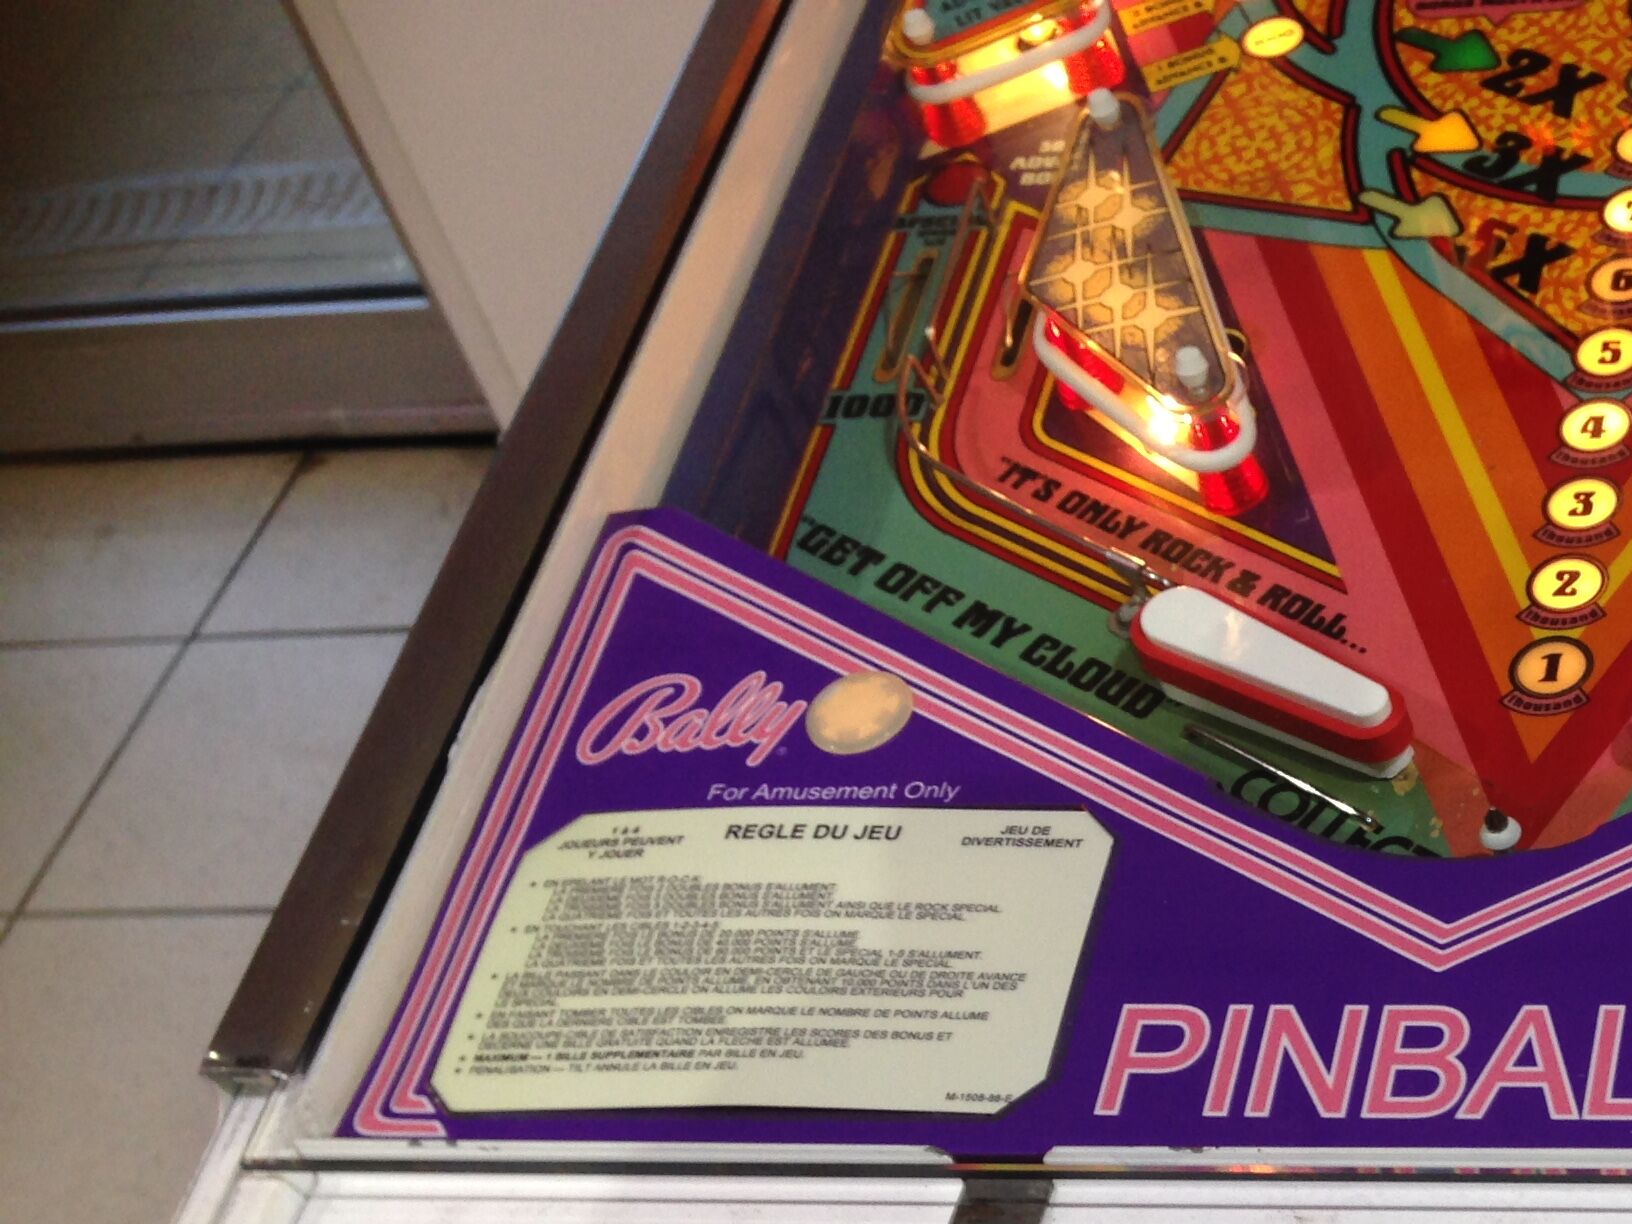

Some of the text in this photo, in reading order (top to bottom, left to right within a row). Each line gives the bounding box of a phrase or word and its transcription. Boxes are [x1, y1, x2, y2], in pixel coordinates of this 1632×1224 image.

[1480, 48, 1606, 119] 2X
[1597, 340, 1622, 365] 5
[1580, 415, 1607, 439] 4
[1567, 490, 1596, 517] 3
[1056, 489, 1144, 541] ONLY
[1139, 527, 1236, 590] ROCK
[1226, 568, 1262, 599] &
[1551, 569, 1581, 597] 2
[874, 561, 967, 615] OFF
[951, 599, 1032, 649] MY
[1537, 652, 1563, 682] 1
[576, 670, 808, 768] Bally
[706, 781, 961, 802] For Amusement Only
[724, 824, 902, 841] REGLE DU JEU
[960, 836, 1084, 849] DIVERTISSEMENT
[999, 825, 1052, 836] JEU DE
